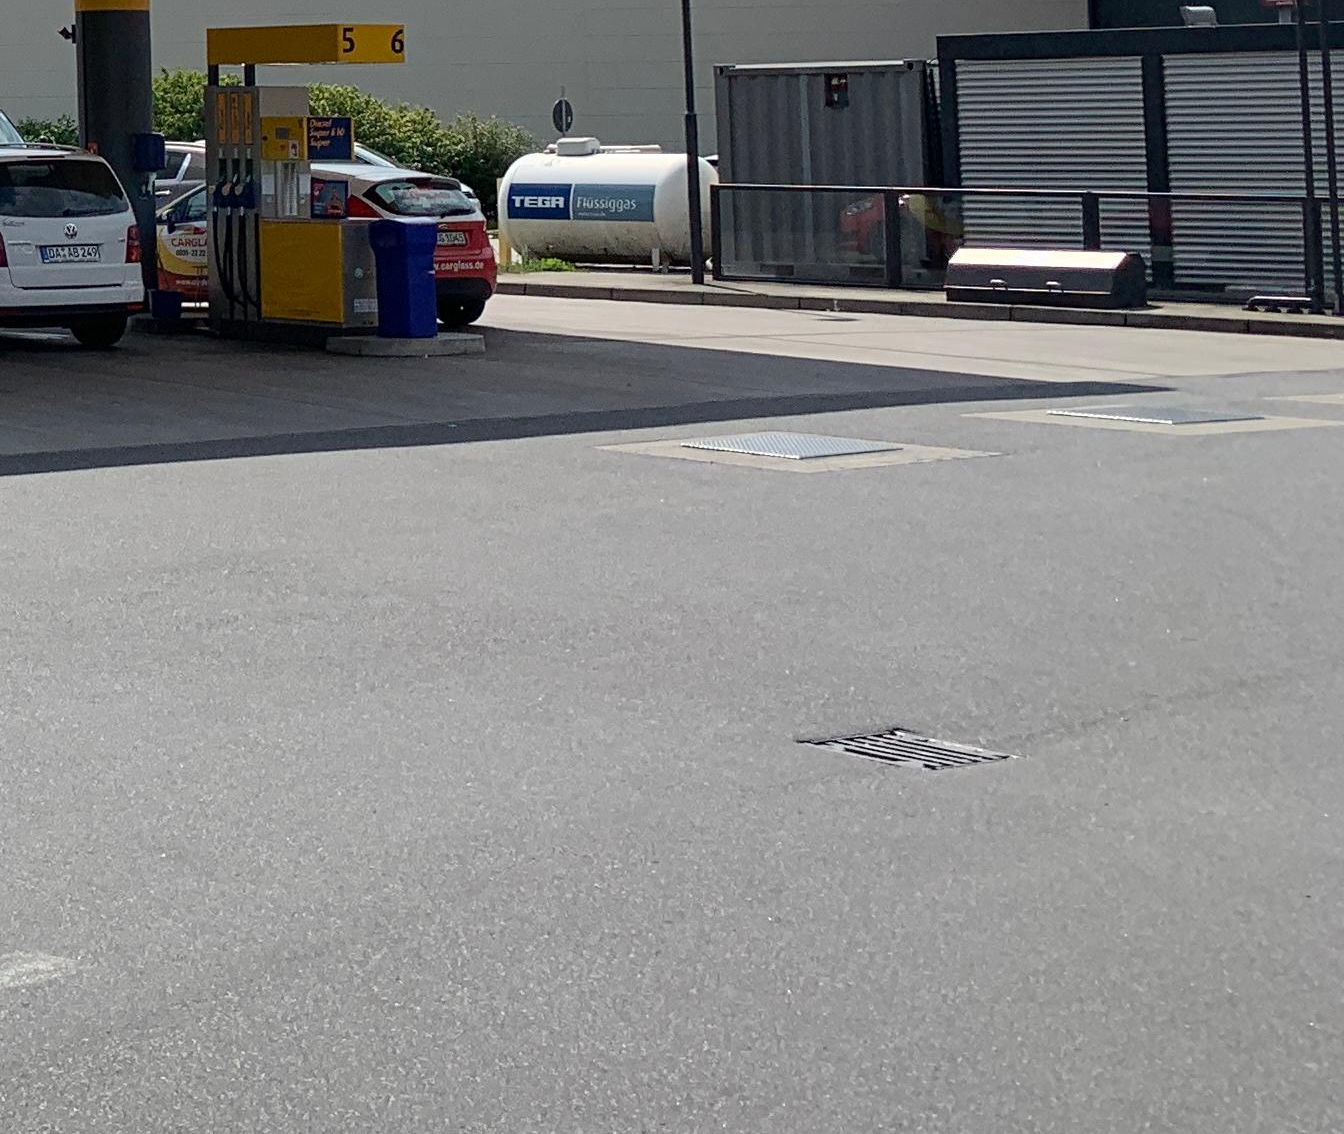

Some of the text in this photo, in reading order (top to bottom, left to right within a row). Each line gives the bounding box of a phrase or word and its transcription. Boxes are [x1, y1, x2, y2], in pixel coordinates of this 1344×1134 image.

[342, 27, 355, 53] 5
[391, 29, 404, 54] 6
[512, 196, 565, 208] TEGA
[576, 196, 637, 213] Flüssiggas
